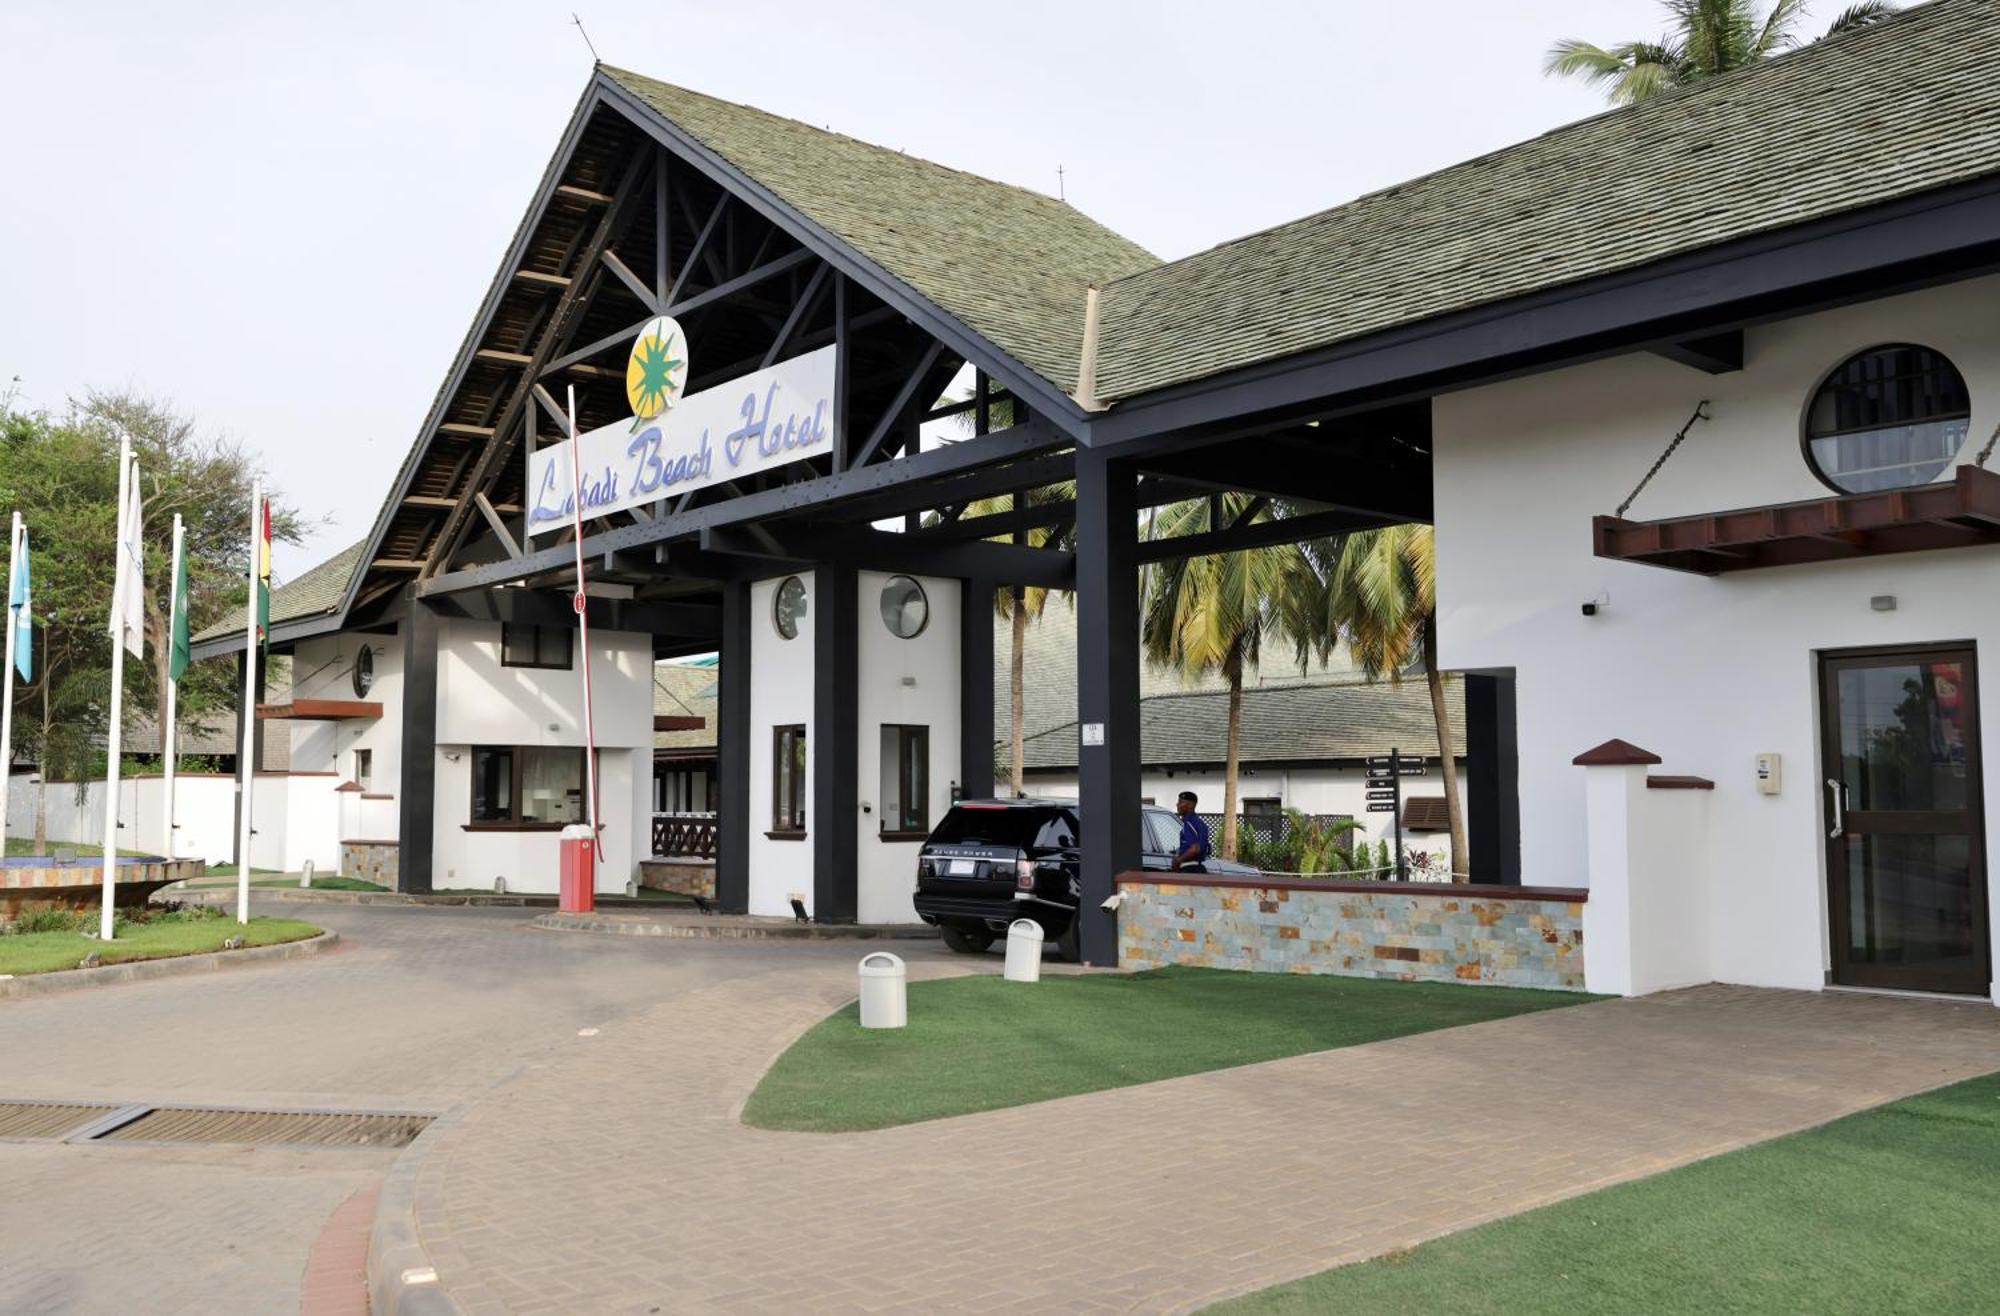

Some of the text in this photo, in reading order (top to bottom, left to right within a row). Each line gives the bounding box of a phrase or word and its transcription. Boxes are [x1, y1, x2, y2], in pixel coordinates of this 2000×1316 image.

[528, 381, 827, 525] Labadi Beach Hotel
